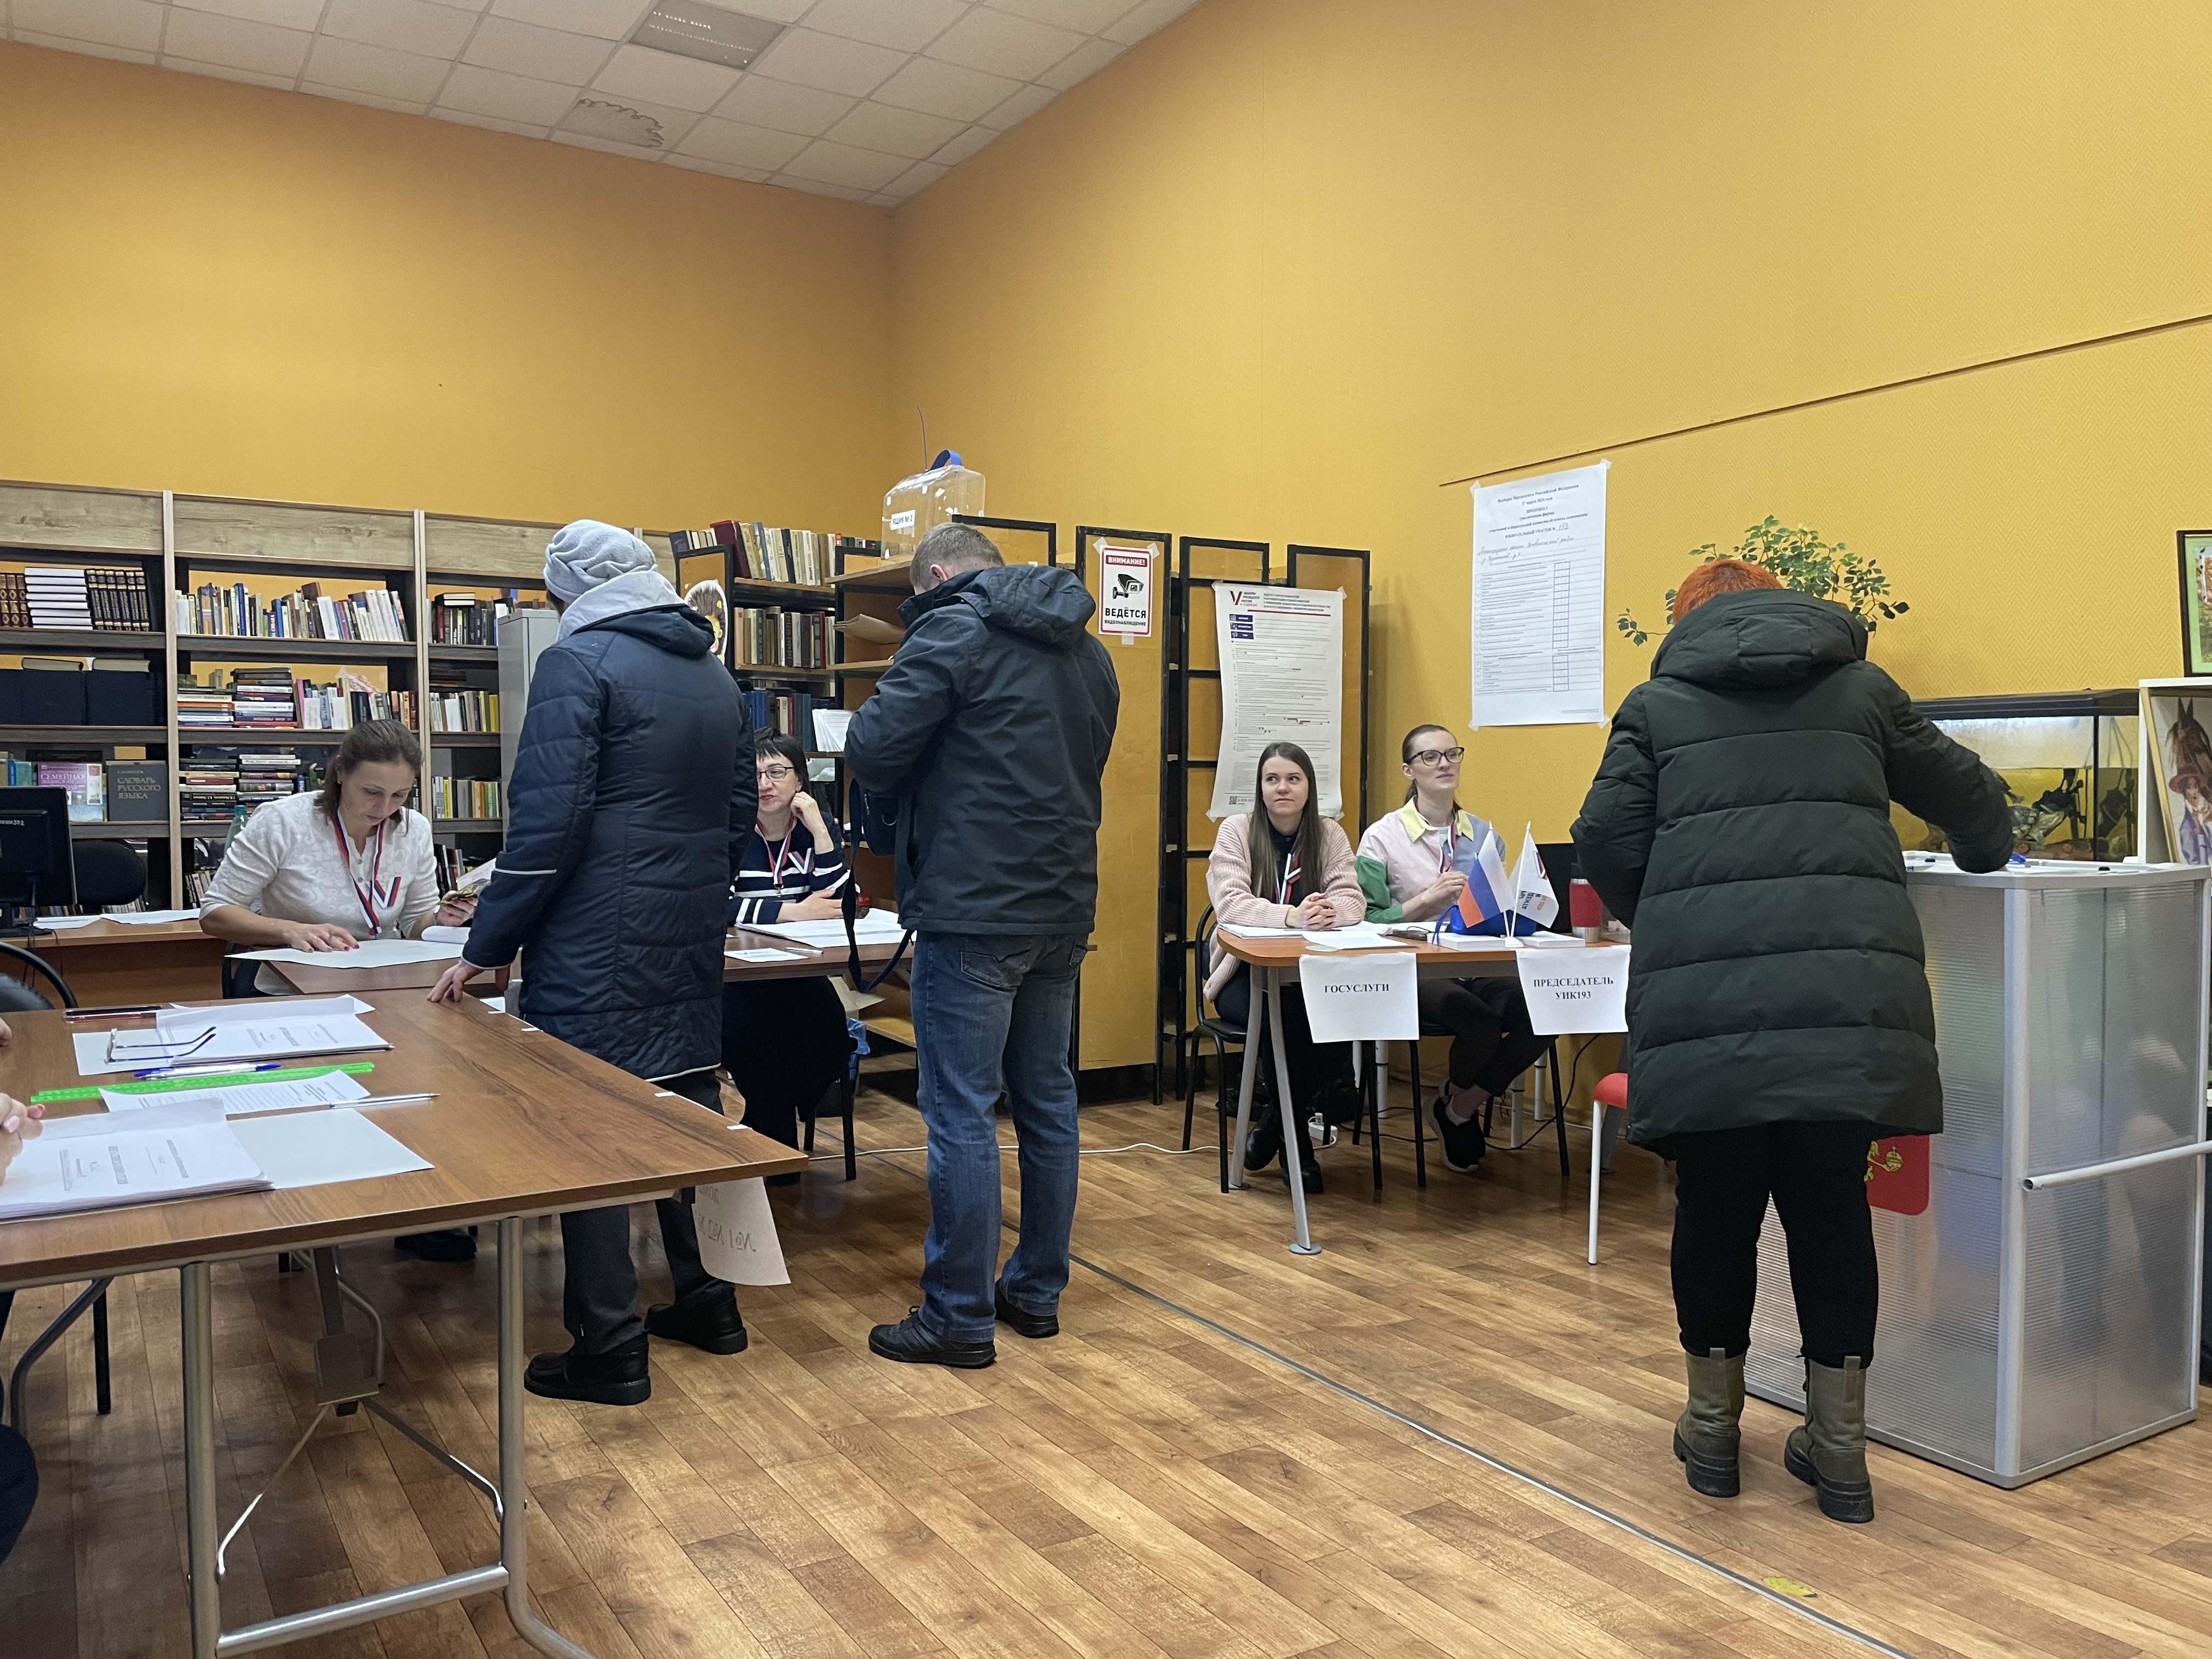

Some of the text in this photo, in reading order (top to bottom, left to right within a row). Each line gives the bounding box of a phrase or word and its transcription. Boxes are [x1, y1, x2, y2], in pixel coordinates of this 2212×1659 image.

[1108, 556, 1146, 566] ВНИМАНИЕ!
[1533, 977, 1613, 988] ПРЕДСЕДАТЕЛЬ
[1324, 984, 1390, 994] ГОСУСЛУГИ
[1555, 991, 1592, 1000] УИК193
